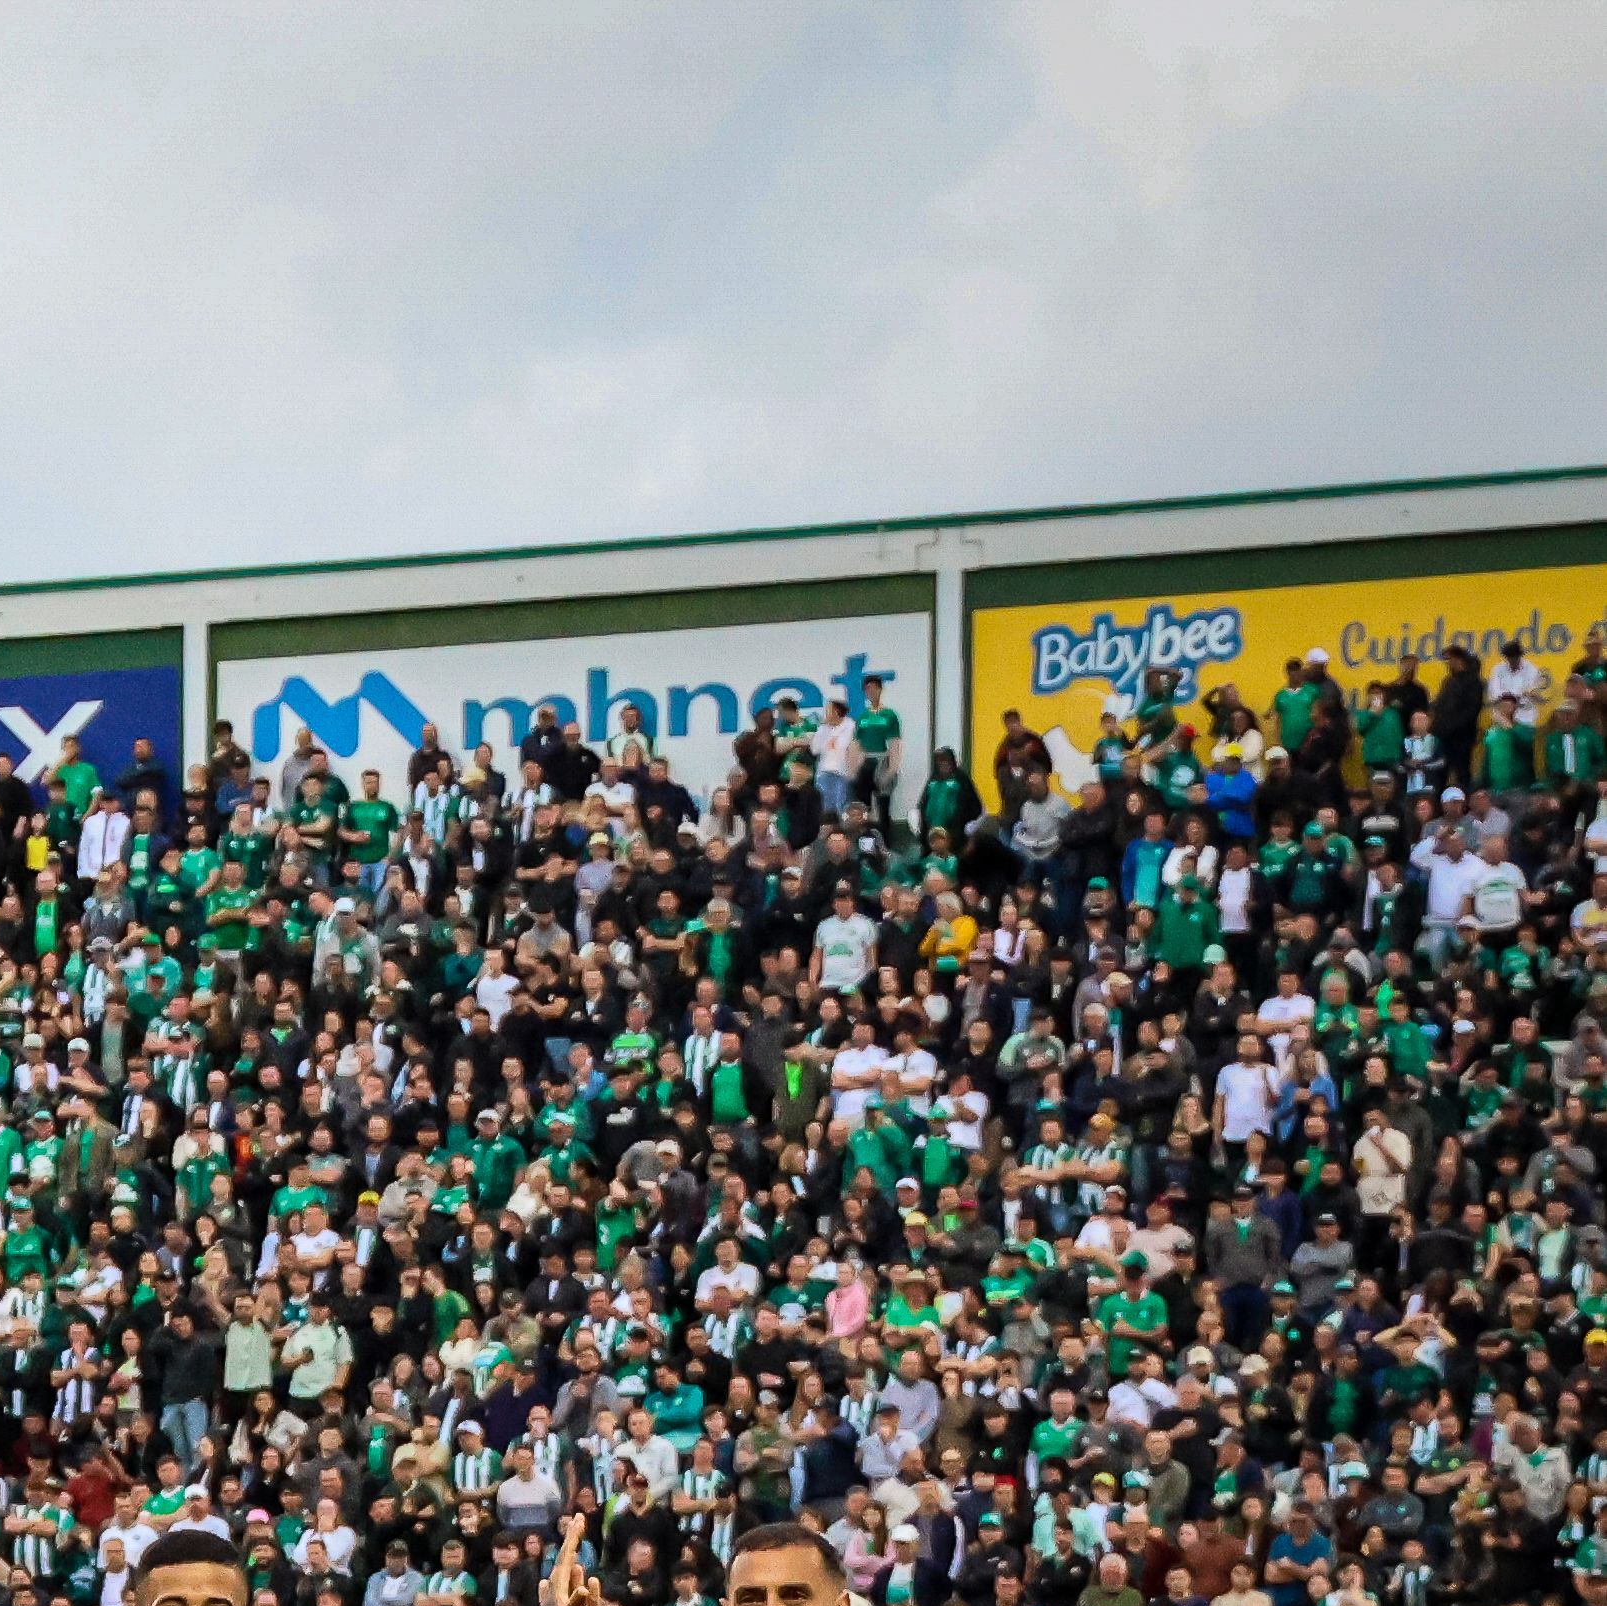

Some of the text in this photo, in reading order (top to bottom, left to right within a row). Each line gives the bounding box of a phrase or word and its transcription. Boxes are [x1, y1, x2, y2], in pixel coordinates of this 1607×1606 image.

[1037, 612, 1236, 689] Babybee
[1341, 608, 1573, 668] Cuidando
[462, 653, 897, 751] mhnet
